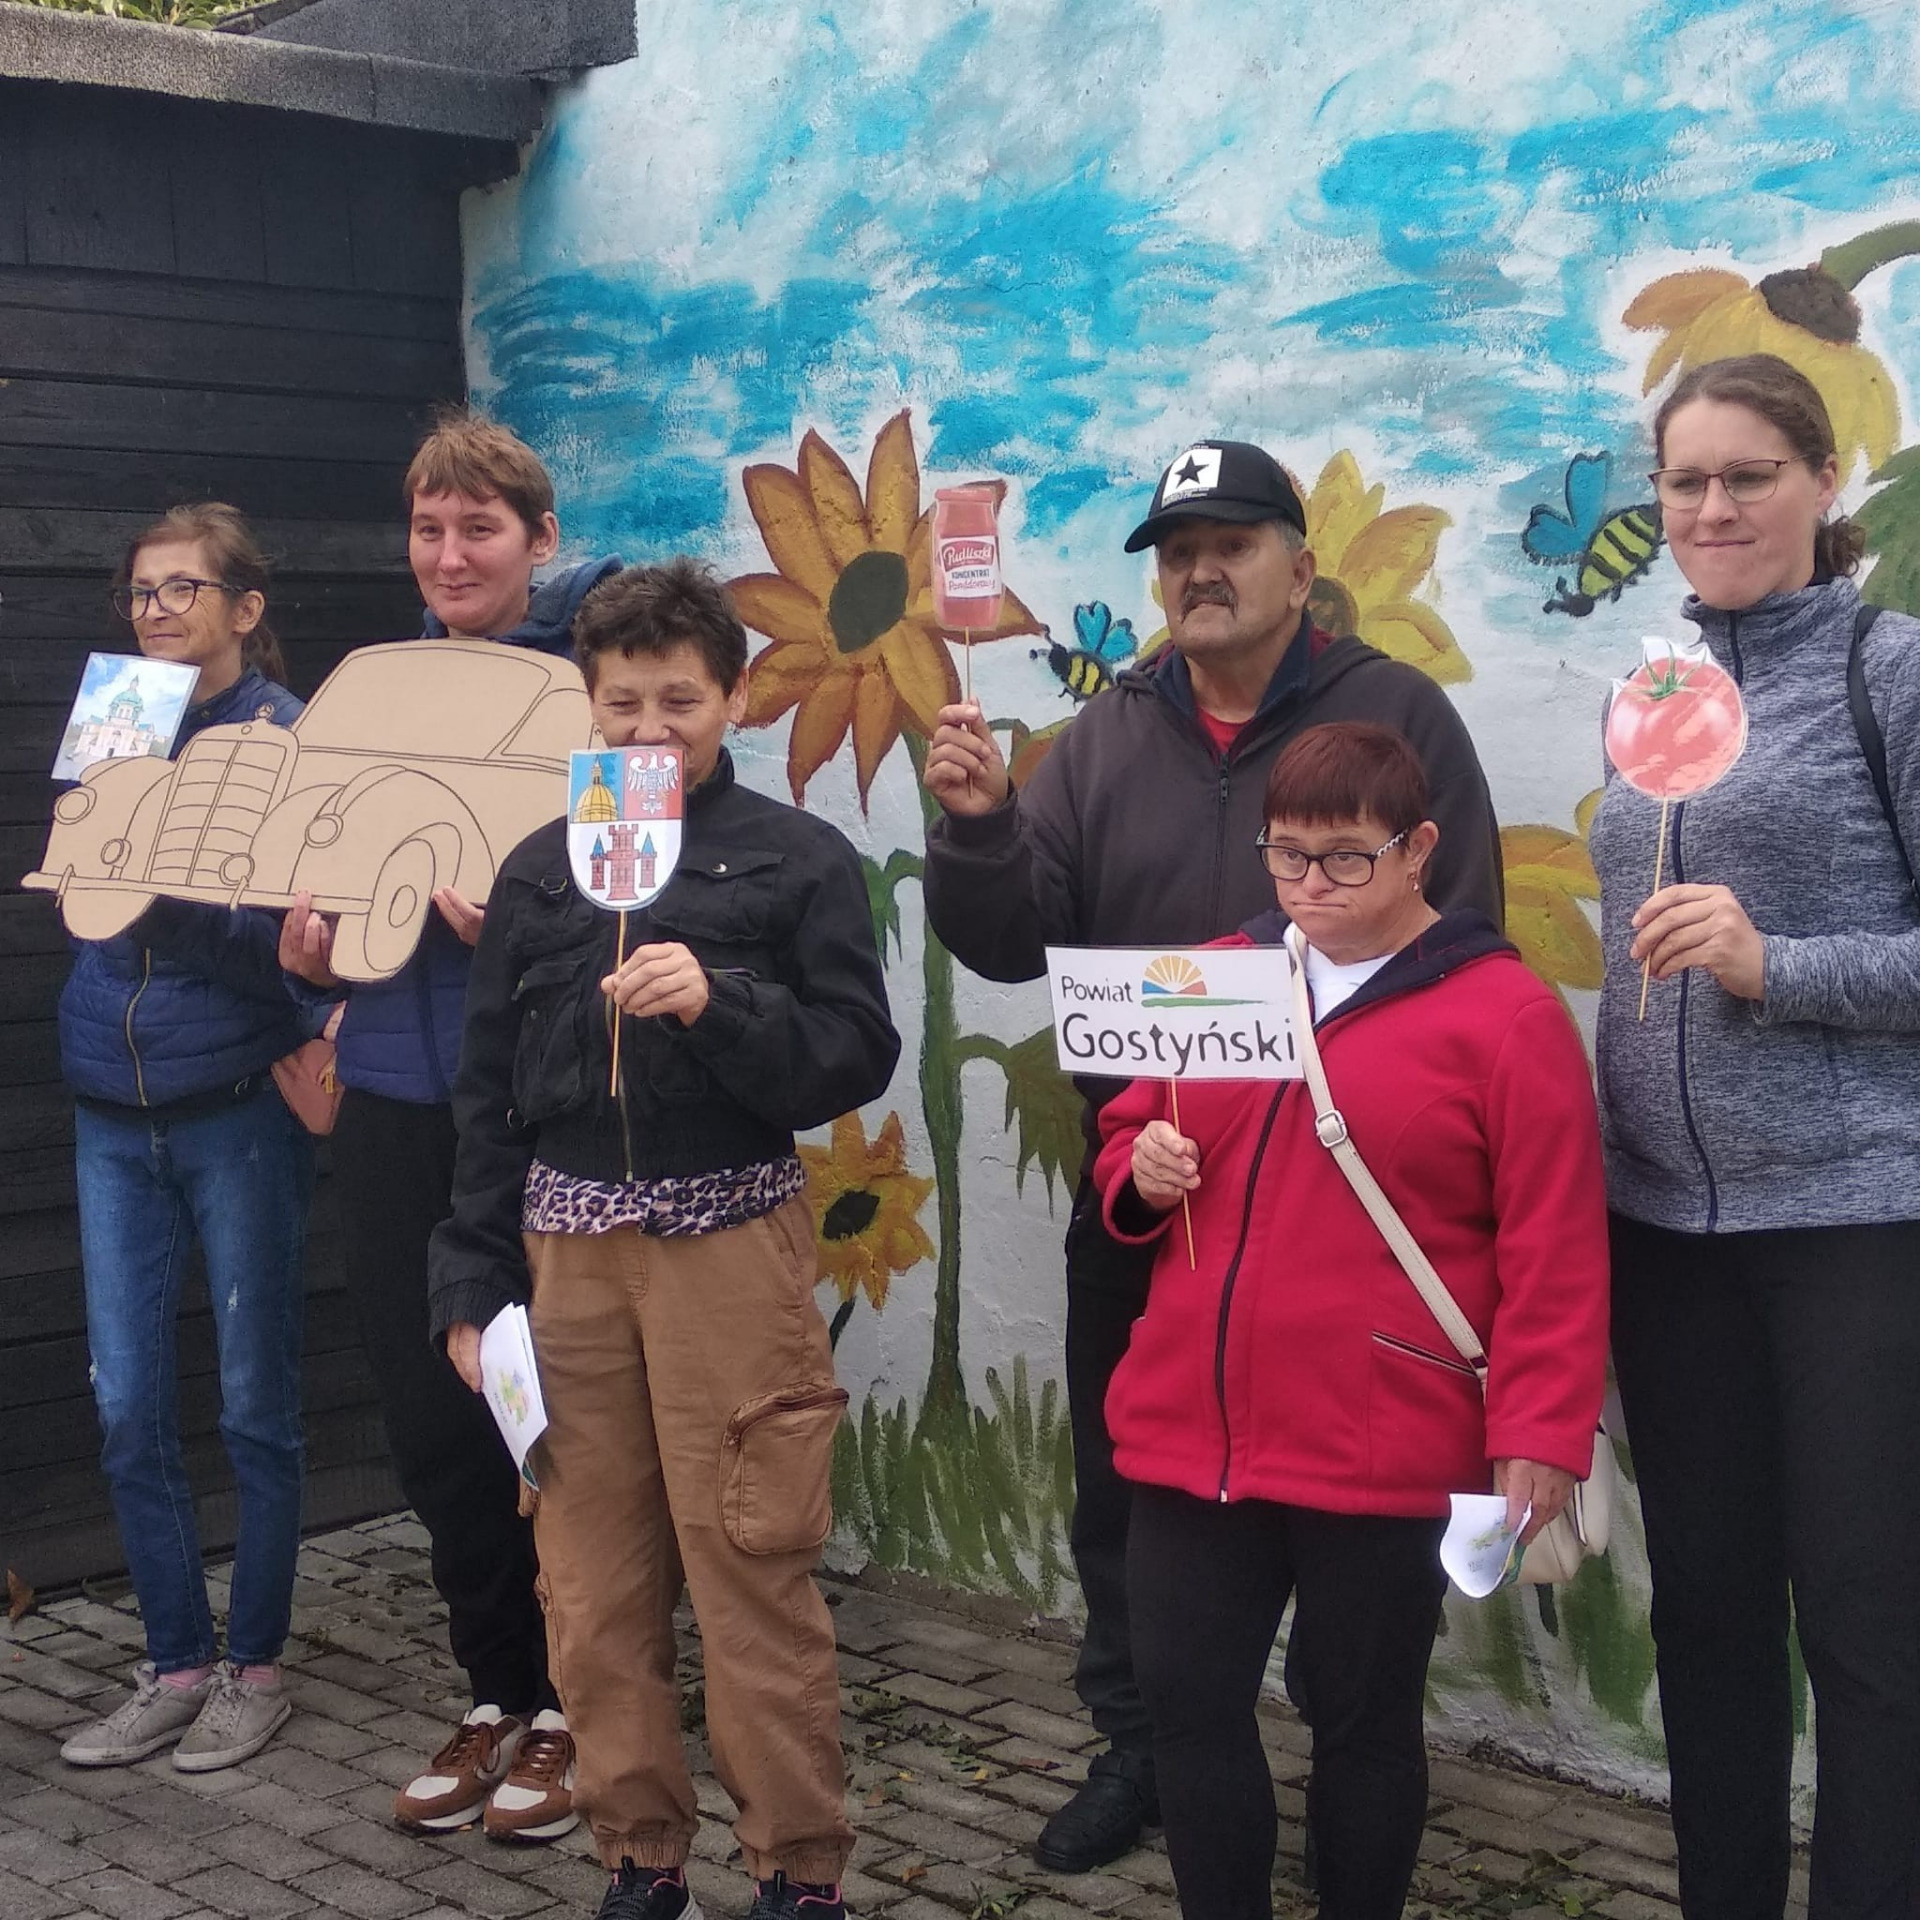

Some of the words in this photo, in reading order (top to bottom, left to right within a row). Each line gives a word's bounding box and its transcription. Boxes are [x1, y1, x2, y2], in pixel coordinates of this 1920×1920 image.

[951, 568, 990, 580] KONCENTRAT
[1061, 975, 1133, 1003] Powiat
[1062, 1012, 1295, 1076] Gostyński
